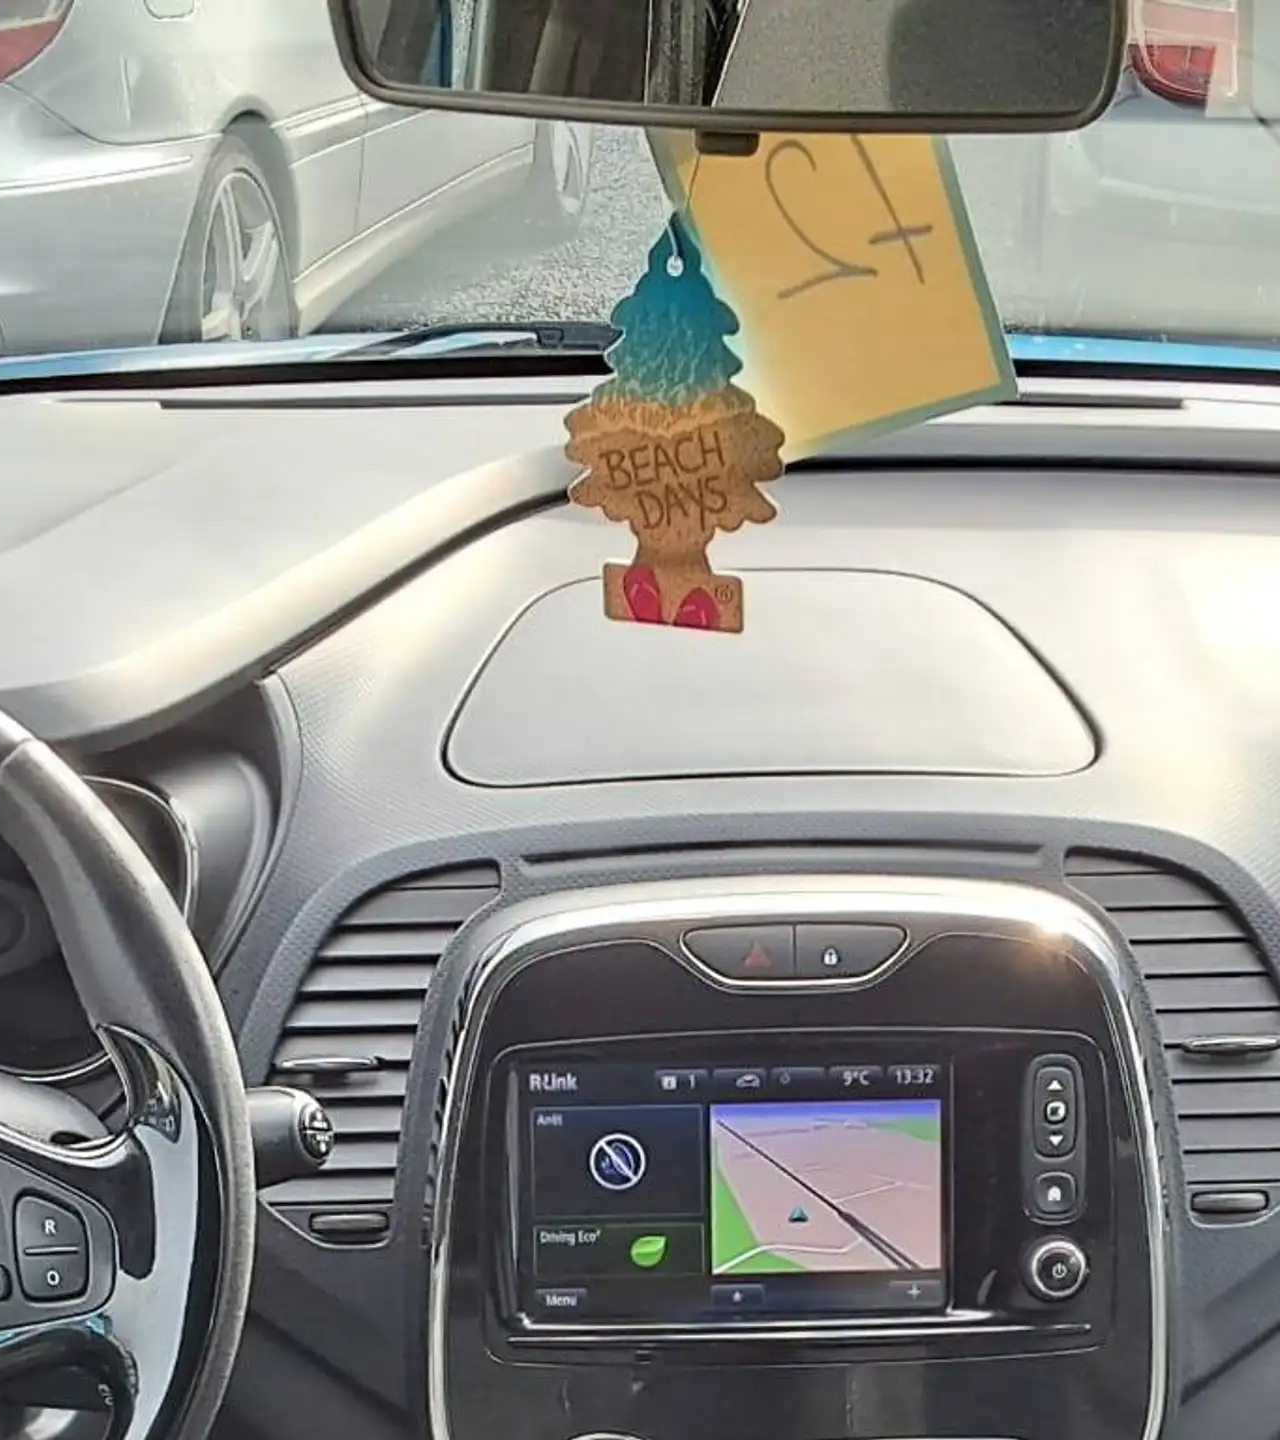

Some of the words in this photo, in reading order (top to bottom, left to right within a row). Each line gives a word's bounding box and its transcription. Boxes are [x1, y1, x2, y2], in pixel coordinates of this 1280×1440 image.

[600, 428, 725, 490] BEACH
[633, 475, 728, 532] DAYS
[894, 1068, 936, 1085] 13:32
[44, 1218, 57, 1236] R
[539, 1229, 576, 1247] Driving
[545, 1294, 578, 1307] Menu
